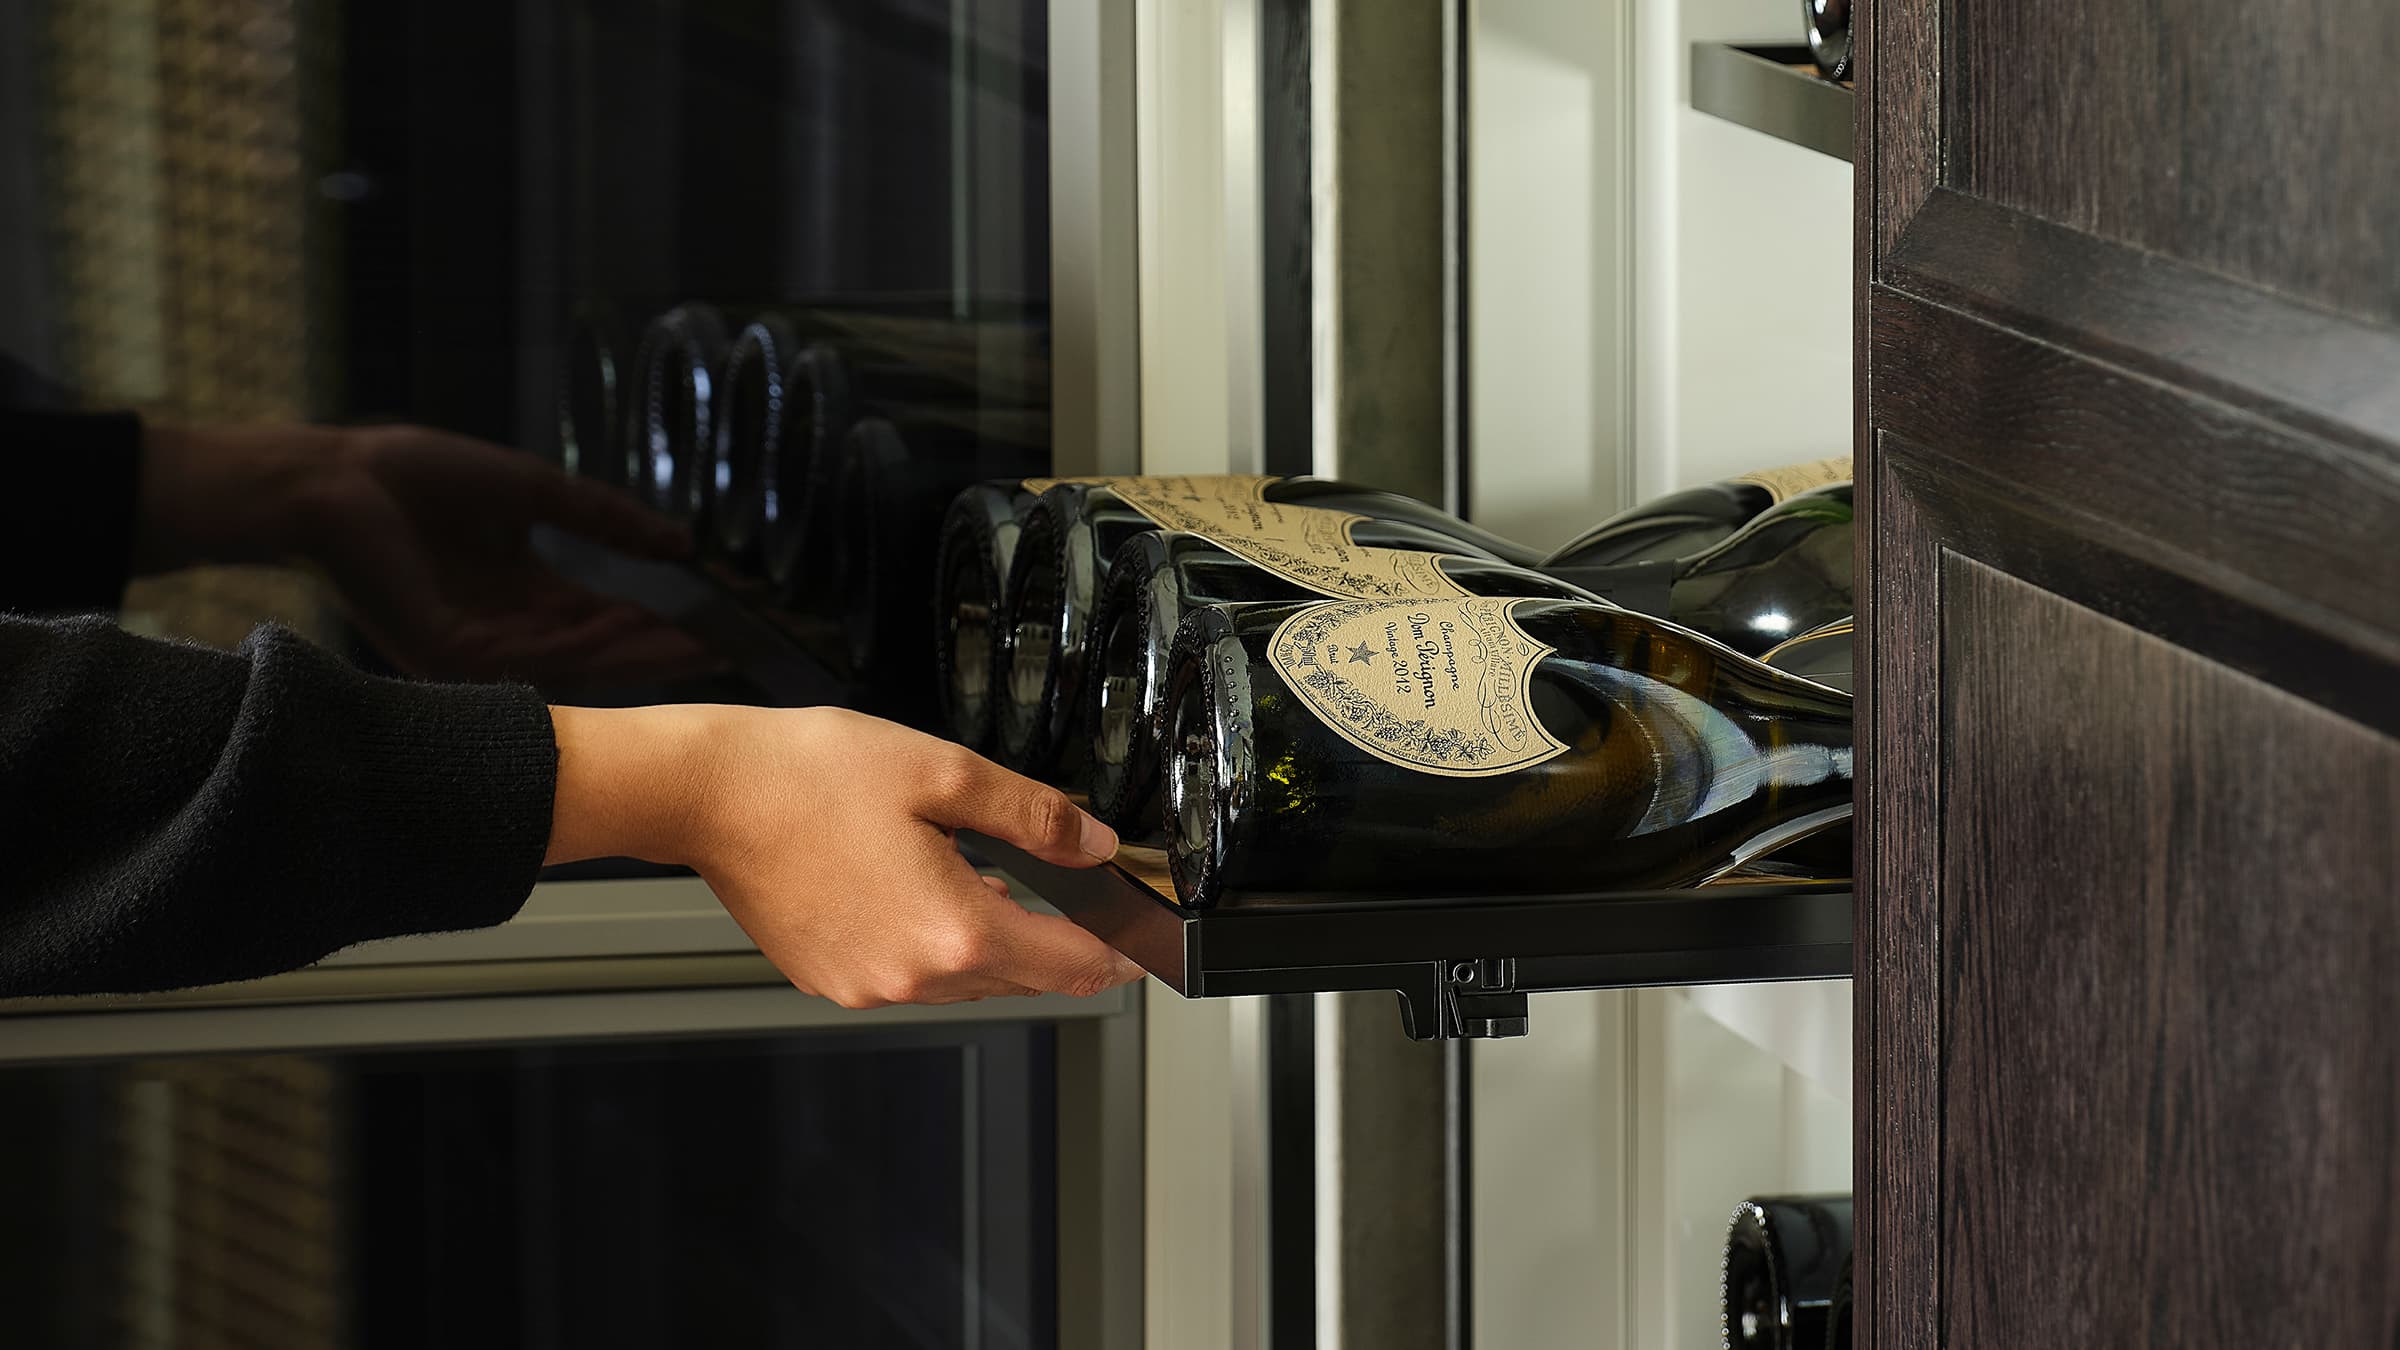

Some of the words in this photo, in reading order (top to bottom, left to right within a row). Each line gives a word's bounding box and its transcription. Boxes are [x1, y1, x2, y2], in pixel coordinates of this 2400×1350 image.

[1407, 612, 1431, 641] Dom
[1326, 644, 1339, 665] Brut
[1384, 621, 1399, 659] Vintage
[1392, 660, 1412, 695] 2012
[1412, 640, 1440, 710] Pérignon
[1439, 621, 1460, 692] Champagne
[1367, 738, 1386, 750] FRANCE
[1419, 756, 1439, 766] FRANCE
